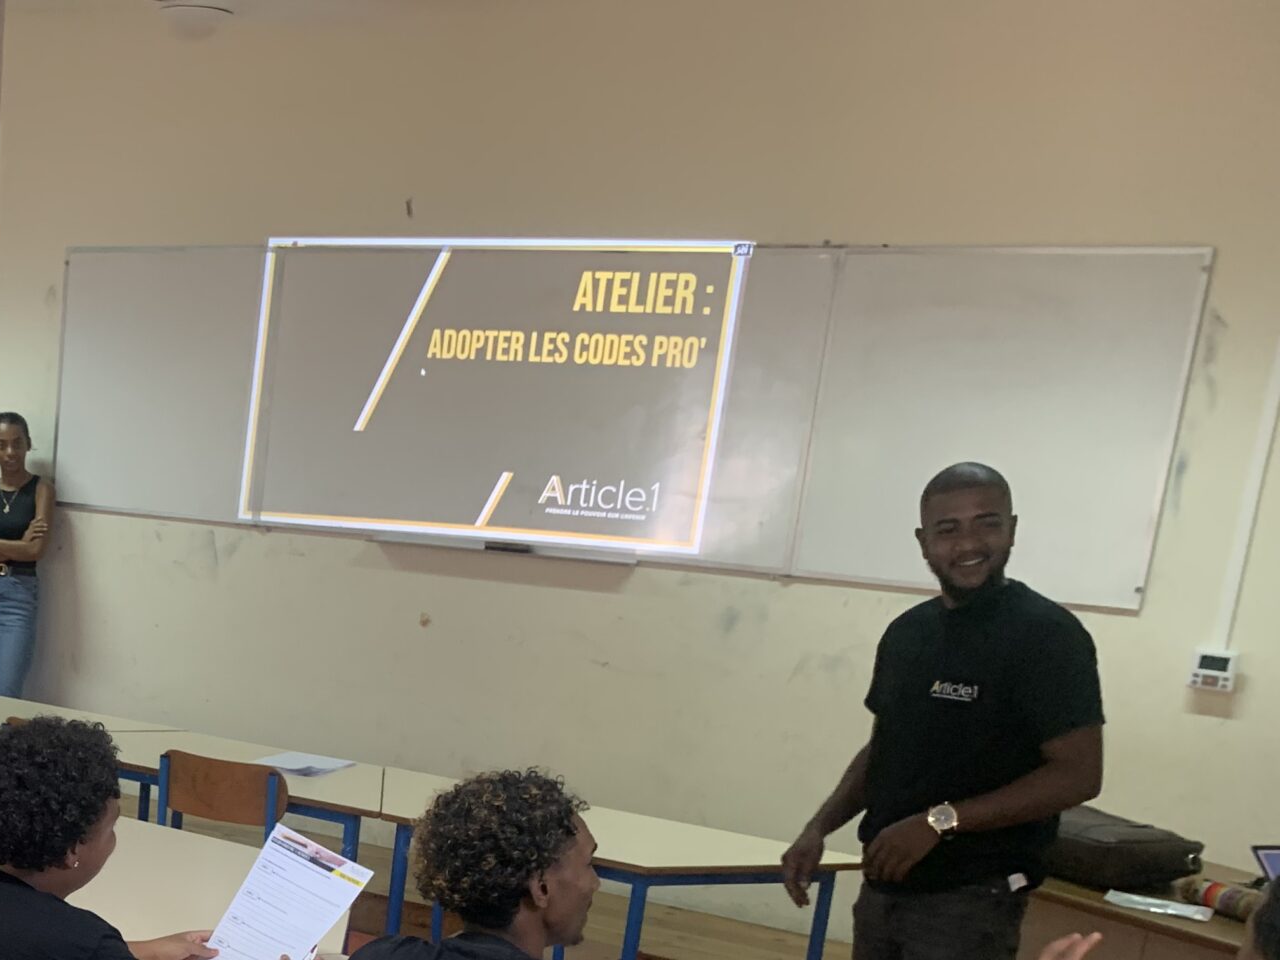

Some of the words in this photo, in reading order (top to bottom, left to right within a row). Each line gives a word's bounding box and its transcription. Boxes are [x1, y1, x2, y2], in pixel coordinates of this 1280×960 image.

[572, 270, 697, 315] ATELIER
[426, 328, 525, 362] ADOPTER
[528, 331, 571, 364] LES
[573, 332, 648, 367] CODES
[651, 335, 708, 369] PRO'
